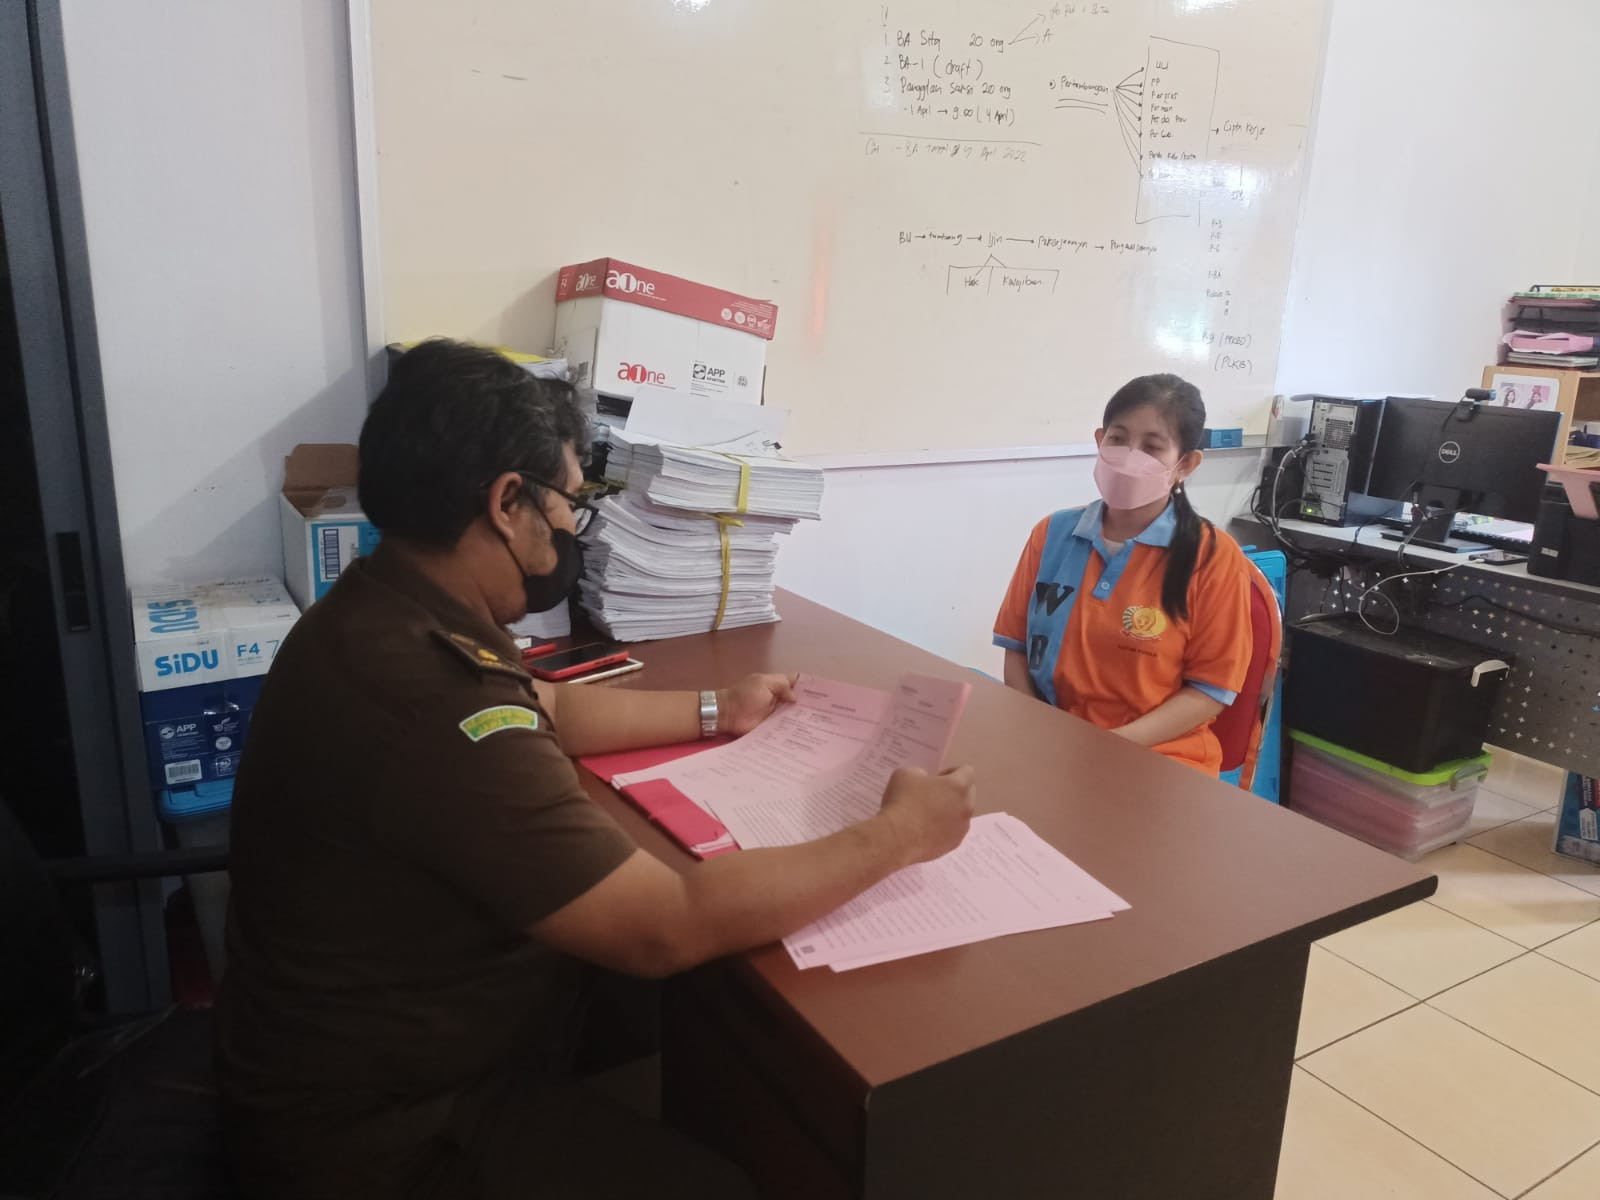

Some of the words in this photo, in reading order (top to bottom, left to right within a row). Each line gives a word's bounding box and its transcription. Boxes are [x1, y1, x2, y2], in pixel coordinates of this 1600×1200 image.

[896, 29, 912, 47] BA
[968, 32, 984, 47] 20
[981, 81, 996, 95] 20
[707, 367, 726, 378] APP
[236, 642, 260, 658] F4
[154, 648, 219, 677] SiDU
[176, 723, 197, 735] APP
